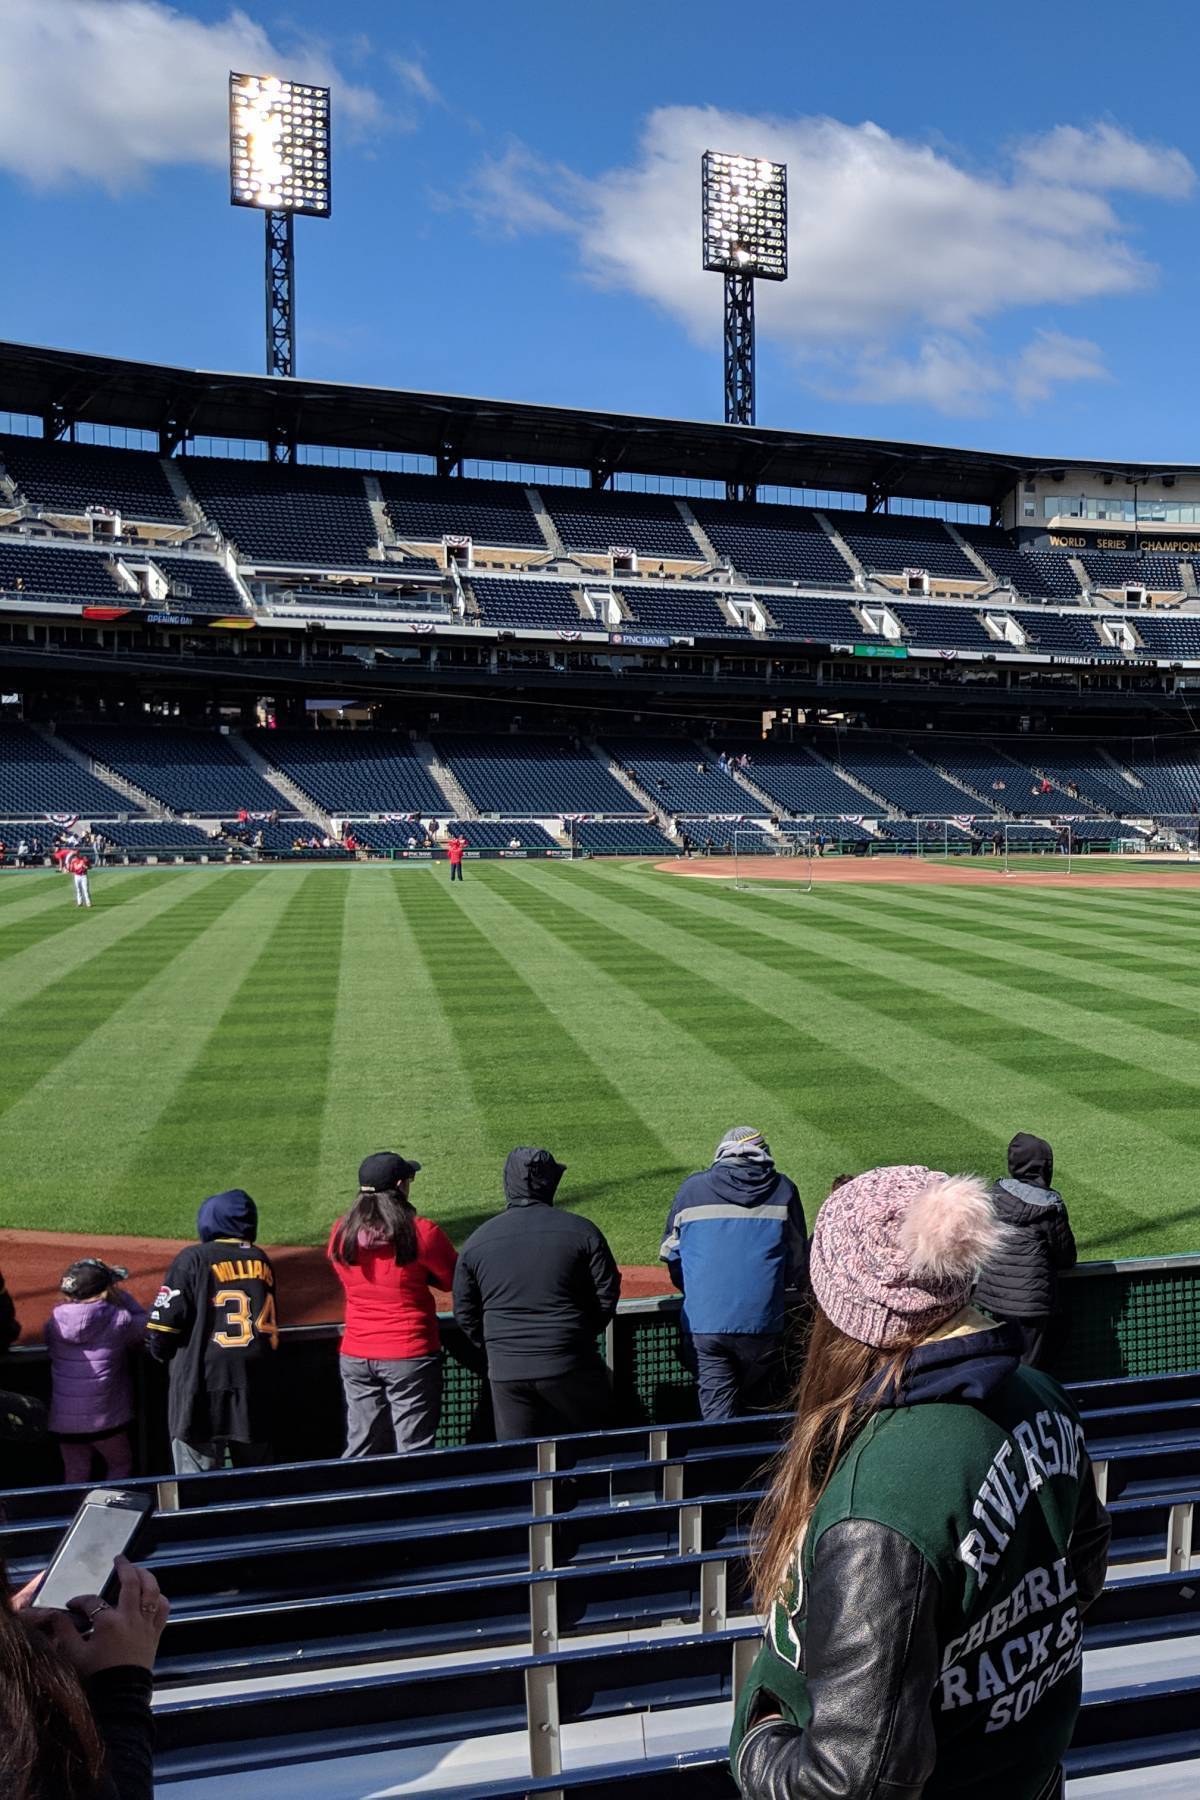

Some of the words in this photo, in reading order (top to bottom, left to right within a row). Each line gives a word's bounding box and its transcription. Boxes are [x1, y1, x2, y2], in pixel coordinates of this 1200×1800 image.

[1050, 535, 1086, 547] WORLD
[1097, 538, 1126, 550] SERIES
[147, 615, 179, 624] OPENING
[213, 1289, 279, 1351] 34
[934, 1623, 1053, 1711] RACK
